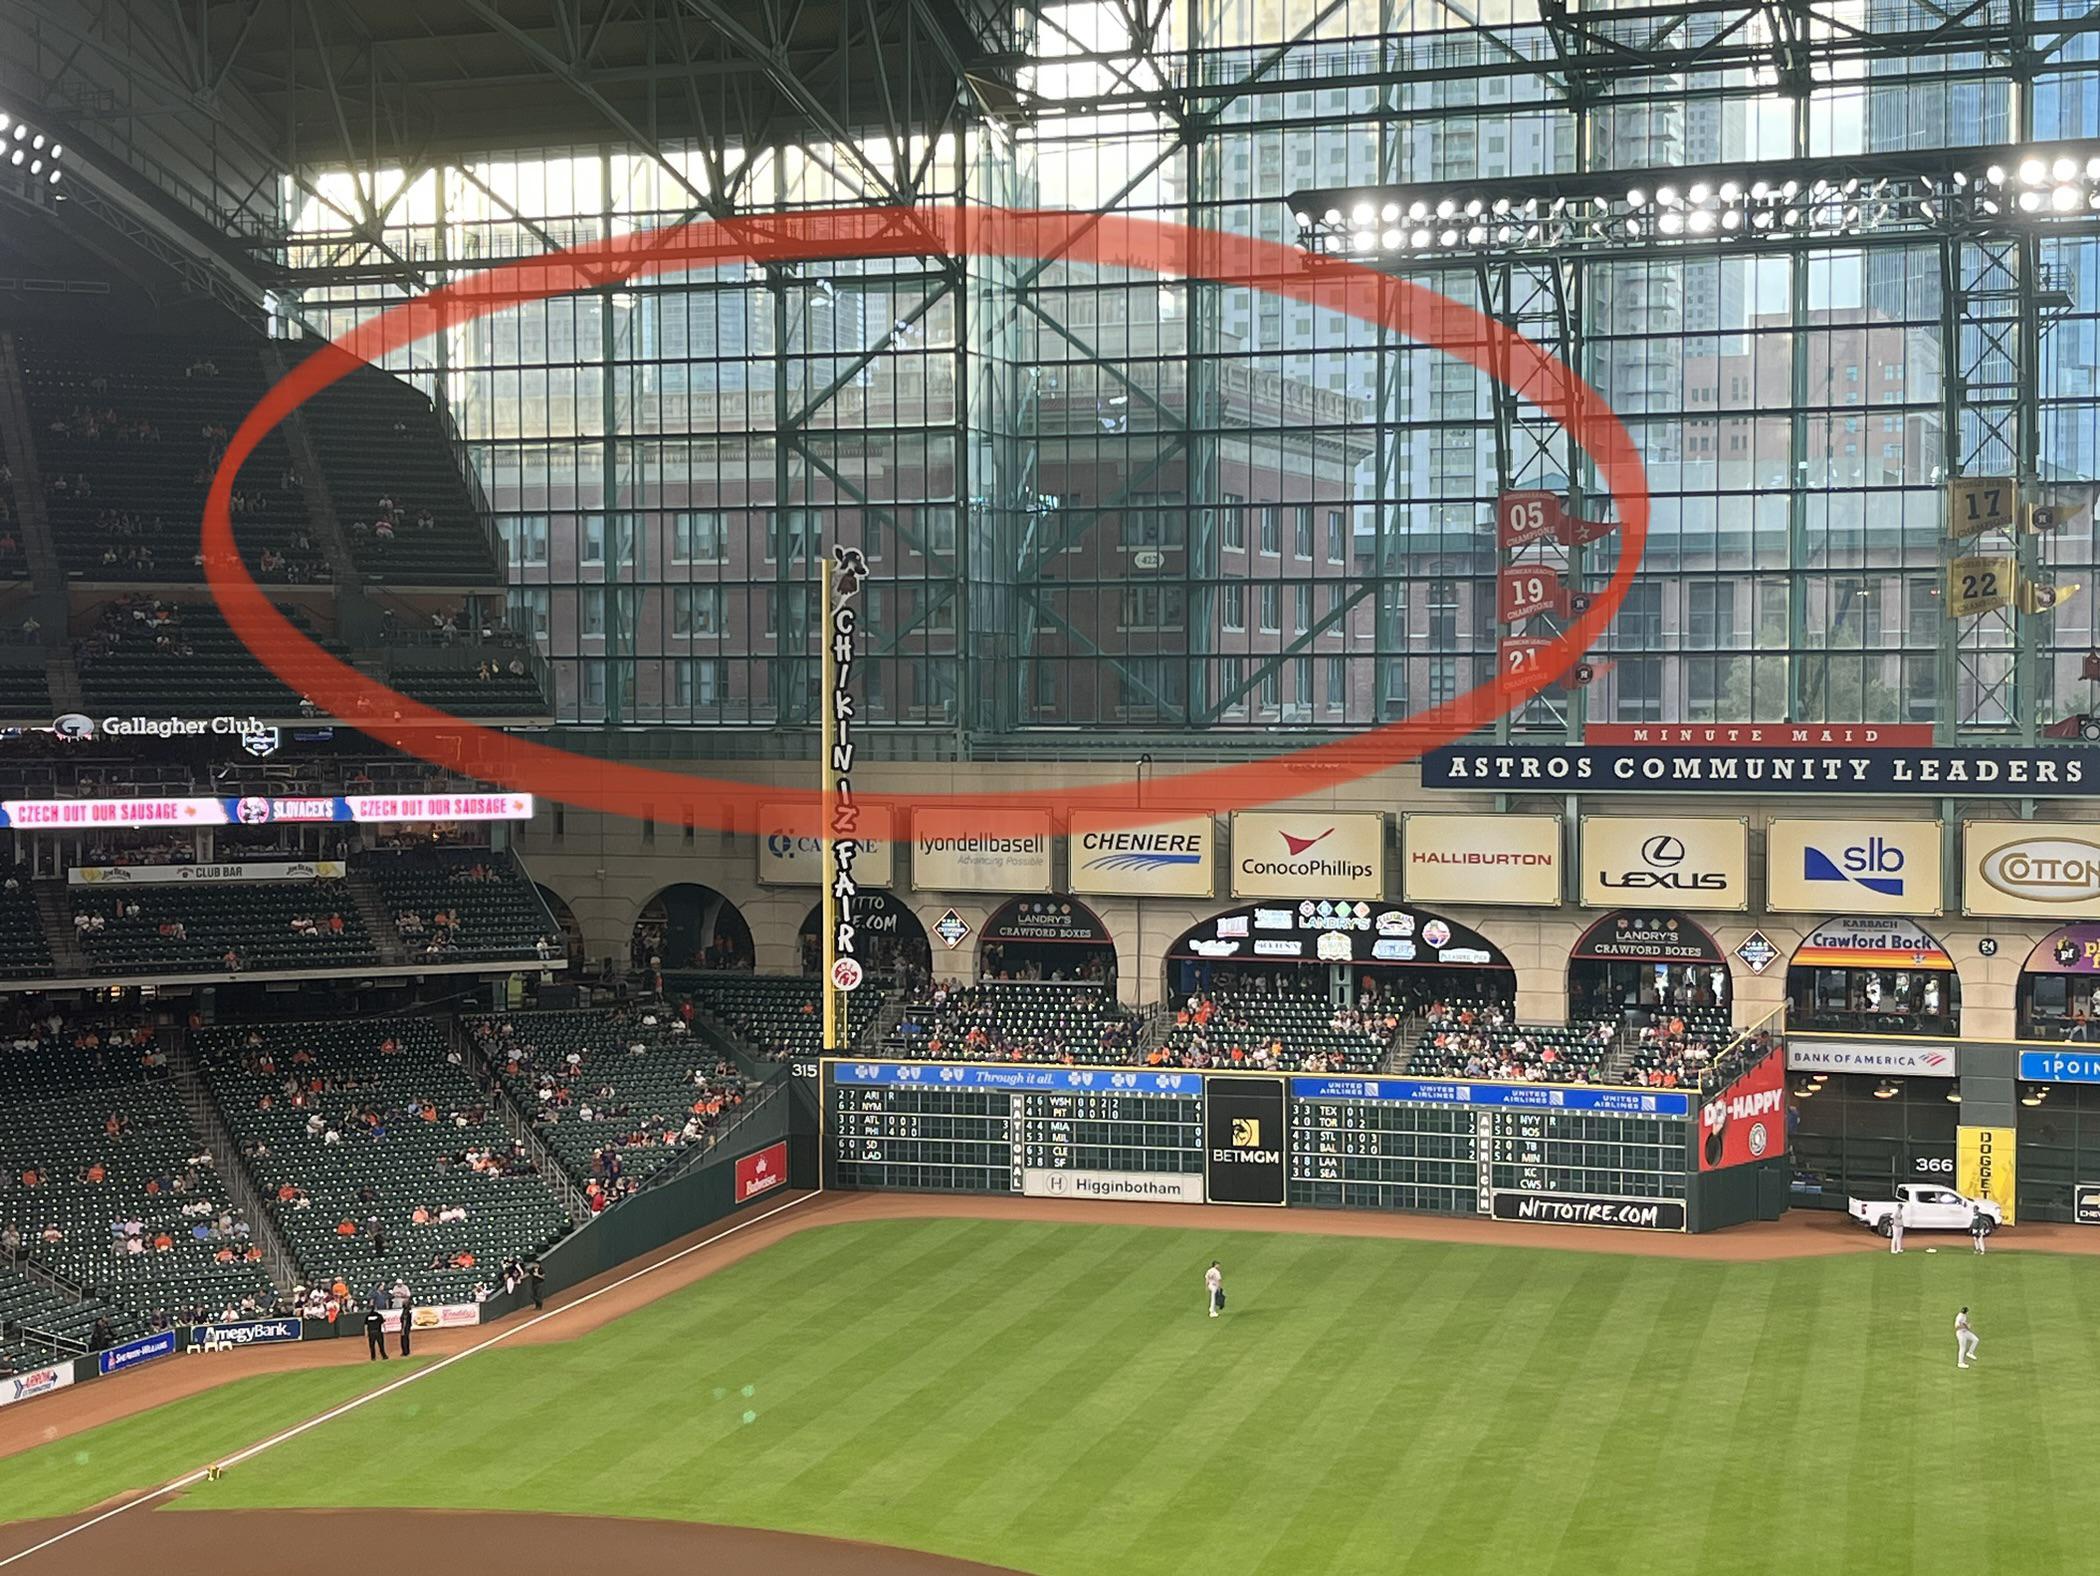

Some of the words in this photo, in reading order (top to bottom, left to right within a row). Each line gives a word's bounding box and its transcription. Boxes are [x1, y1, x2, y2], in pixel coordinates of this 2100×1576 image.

[1966, 490, 2000, 520] 17
[1510, 502, 1544, 531] 05
[1506, 526, 1556, 547] CHAMPIONS
[1512, 578, 1543, 605] 19
[1962, 572, 1996, 599] 22
[1507, 601, 1554, 620] CHAMPIONS
[1510, 648, 1540, 674] 21
[834, 609, 853, 772] CHIKIN
[102, 717, 208, 738] Gallagher
[212, 717, 264, 734] Club
[1634, 730, 1762, 742] MINUTE
[1793, 730, 1880, 742] MAID
[1449, 756, 1592, 778] ASTROS
[1614, 758, 1870, 780] COMMUNITY
[1894, 759, 2083, 782] LEADERS
[18, 806, 58, 822] CZECH
[64, 805, 86, 822] OUT
[92, 804, 116, 820] OUR
[120, 804, 178, 820] SAUSAGE
[360, 800, 390, 817] CZECH
[396, 800, 422, 816] OUT
[428, 799, 451, 816] OUR
[456, 797, 506, 815] SAUSAGE
[798, 838, 878, 854] CANE
[920, 831, 1044, 855] lyondellbasell
[1083, 832, 1200, 852] CHENIERE
[1412, 852, 1552, 866] HALLIBURTON
[1844, 837, 1904, 872] slb
[958, 855, 1002, 867] Advancing
[1006, 855, 1044, 867] Possible
[196, 867, 220, 878] CLUB
[223, 866, 242, 877] BAR
[1242, 858, 1372, 881] ConocoPhillips
[1600, 870, 1727, 890] LEXUS
[1018, 915, 1072, 924] LANDRY'S
[1299, 916, 1371, 930] LANDRY'S
[1842, 920, 1898, 928] KARBACH
[1000, 928, 1056, 938] CRAWFORD
[1060, 928, 1092, 938] BOXES
[1616, 931, 1678, 941] LANDRY'S
[1813, 933, 1886, 948] Crawford
[1892, 935, 1932, 950] Bock
[1982, 941, 1994, 950] 24
[1595, 944, 1660, 955] CRAWFORD
[1665, 946, 1702, 956] BOXES
[1794, 1054, 1830, 1063] BANK
[1834, 1054, 1851, 1064] OF
[1854, 1055, 1916, 1066] AMERICA
[792, 1064, 818, 1078] 315
[976, 1072, 1026, 1084] Through
[1026, 1074, 1036, 1083] it
[864, 1091, 880, 1100] ARI
[888, 1092, 894, 1100] R
[862, 1102, 882, 1111] NYM
[1050, 1098, 1072, 1107] WSH
[1053, 1108, 1068, 1117] PIT
[1320, 1106, 1338, 1116] TEX
[864, 1116, 880, 1125] ATL
[1051, 1122, 1070, 1131] MIA
[1319, 1118, 1338, 1128] TOR
[1520, 1116, 1541, 1125] NYY
[865, 1127, 878, 1136] PHI
[1052, 1133, 1068, 1142] MIL
[1320, 1132, 1336, 1141] STL
[1522, 1128, 1540, 1137] BOS
[866, 1140, 878, 1149] SD
[1013, 1098, 1022, 1187] NATIONAL
[1320, 1144, 1336, 1153] BAL
[1526, 1142, 1537, 1151] TB
[862, 1151, 882, 1160] LAD
[1053, 1146, 1068, 1156] CLE
[1213, 1150, 1280, 1164] BETMGM
[1054, 1158, 1066, 1167] SF
[1319, 1157, 1337, 1166] LAA
[1480, 1116, 1490, 1209] AMERICAN
[1522, 1153, 1540, 1163] MIN
[1916, 1158, 1953, 1172] 366
[1320, 1168, 1337, 1178] SEA
[1524, 1168, 1537, 1177] KC
[1076, 1178, 1181, 1196] Higginbotham
[1520, 1179, 1542, 1189] CWS
[1518, 1197, 1658, 1227] NITTOTIRE.COM
